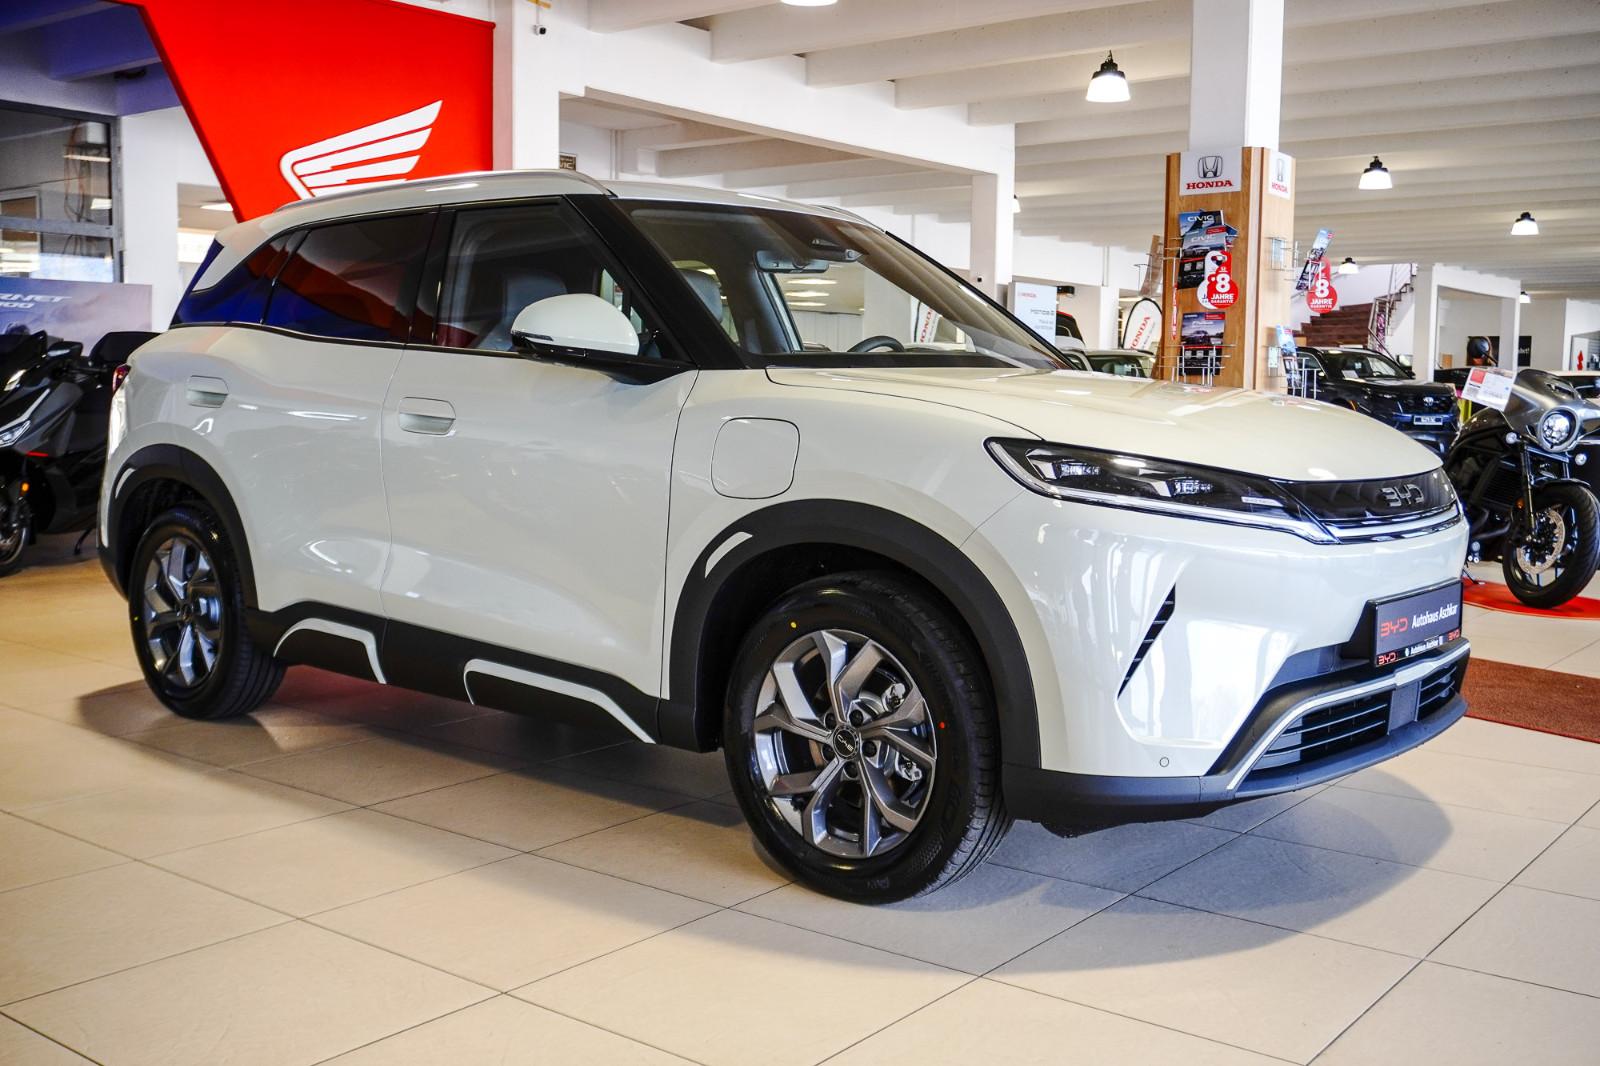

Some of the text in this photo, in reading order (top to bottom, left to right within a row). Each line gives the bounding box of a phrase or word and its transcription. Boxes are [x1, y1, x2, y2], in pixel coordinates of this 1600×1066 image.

[1186, 180, 1233, 190] HONDA
[1272, 182, 1288, 193] HONDA
[1216, 273, 1230, 293] 8
[1315, 279, 1329, 298] 8
[1382, 483, 1424, 507] BYD
[1380, 616, 1408, 637] BYD
[1412, 610, 1439, 629] Autohaus
[1447, 629, 1460, 641] BYD
[1378, 652, 1397, 665] BYD
